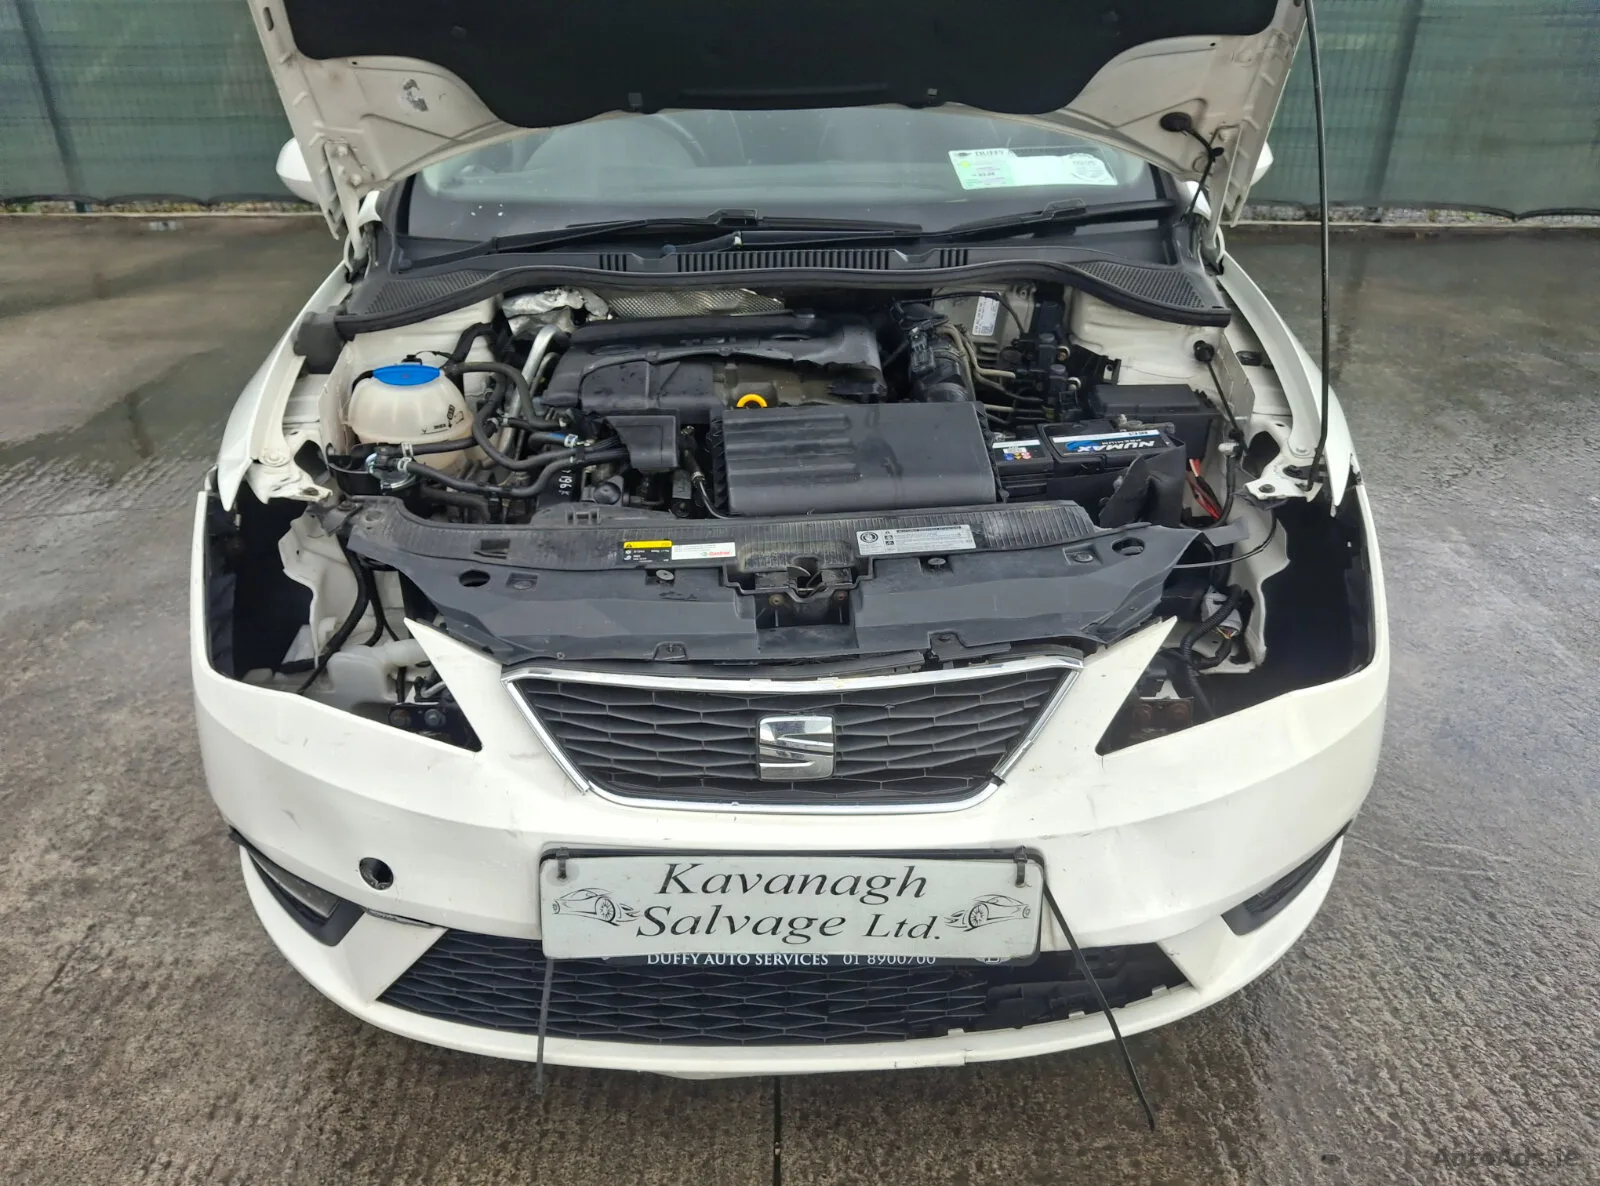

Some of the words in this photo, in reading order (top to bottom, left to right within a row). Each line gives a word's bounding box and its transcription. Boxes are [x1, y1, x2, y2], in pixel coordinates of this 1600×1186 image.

[1077, 441, 1155, 453] NUMAX
[656, 863, 927, 905] Kavanagh
[636, 905, 845, 944] Salvage
[862, 911, 942, 941] Ltd.
[647, 953, 700, 965] DUFFY
[704, 953, 750, 965] AUTO
[756, 953, 829, 965] SERVICES
